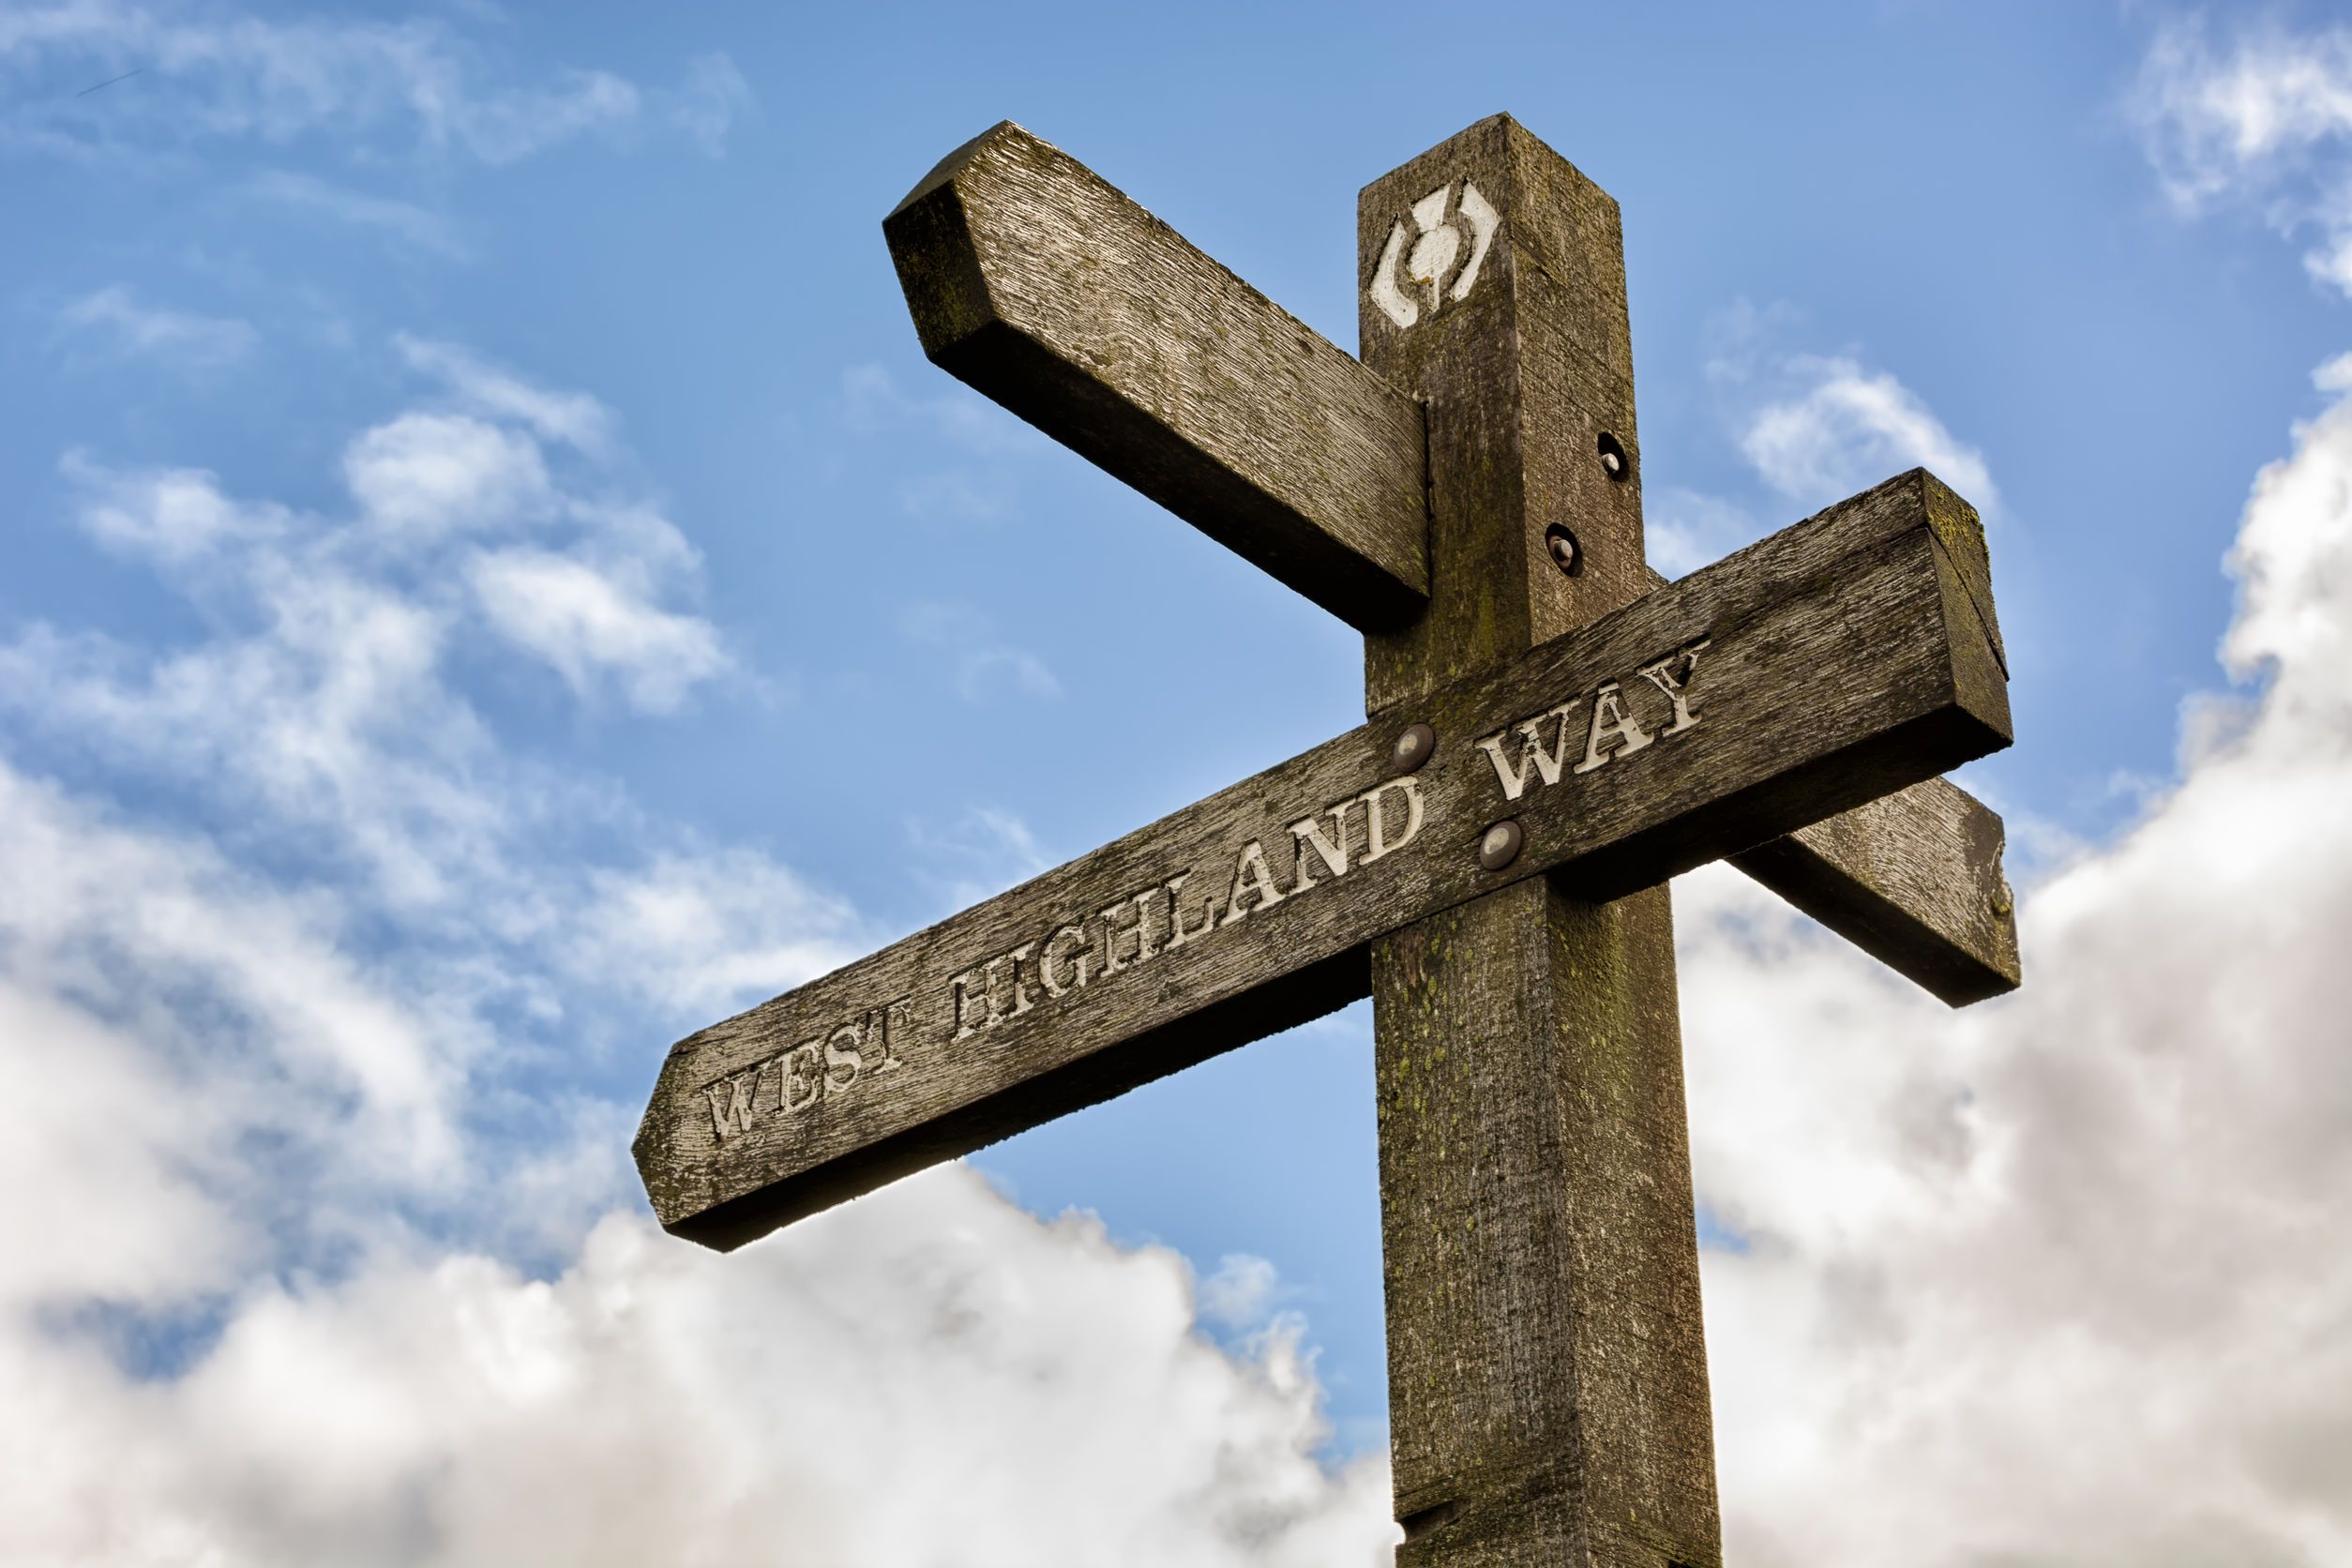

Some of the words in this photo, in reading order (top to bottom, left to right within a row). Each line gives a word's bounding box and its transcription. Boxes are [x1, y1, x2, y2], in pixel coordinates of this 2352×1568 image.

[701, 995, 912, 1142] WEST
[948, 775, 1425, 1042] HIGHLAND
[1472, 633, 1711, 800] WAY
